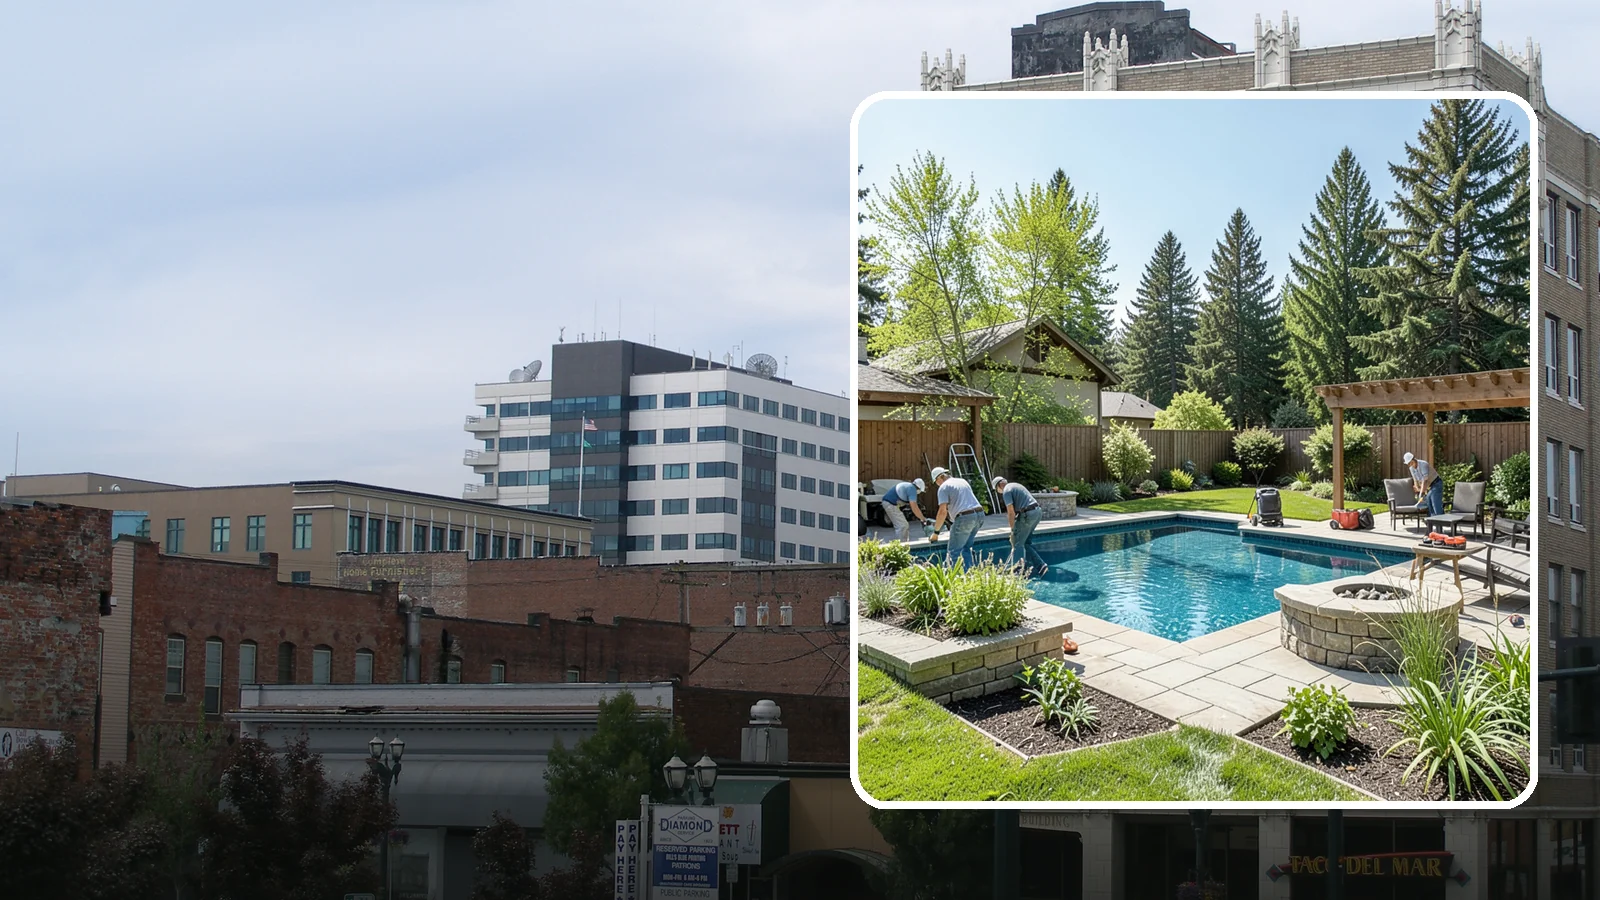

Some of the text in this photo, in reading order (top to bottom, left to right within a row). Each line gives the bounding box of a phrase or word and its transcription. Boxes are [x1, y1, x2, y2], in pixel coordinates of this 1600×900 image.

[370, 566, 427, 576] Furnishers
[660, 818, 713, 832] DIAMOND
[1022, 815, 1070, 828] BUILDING
[628, 824, 636, 893] PAY HERE
[722, 852, 739, 862] Soup
[1345, 856, 1384, 875] DEL
[1392, 857, 1442, 876] MAR
[684, 890, 710, 898] PARKING
